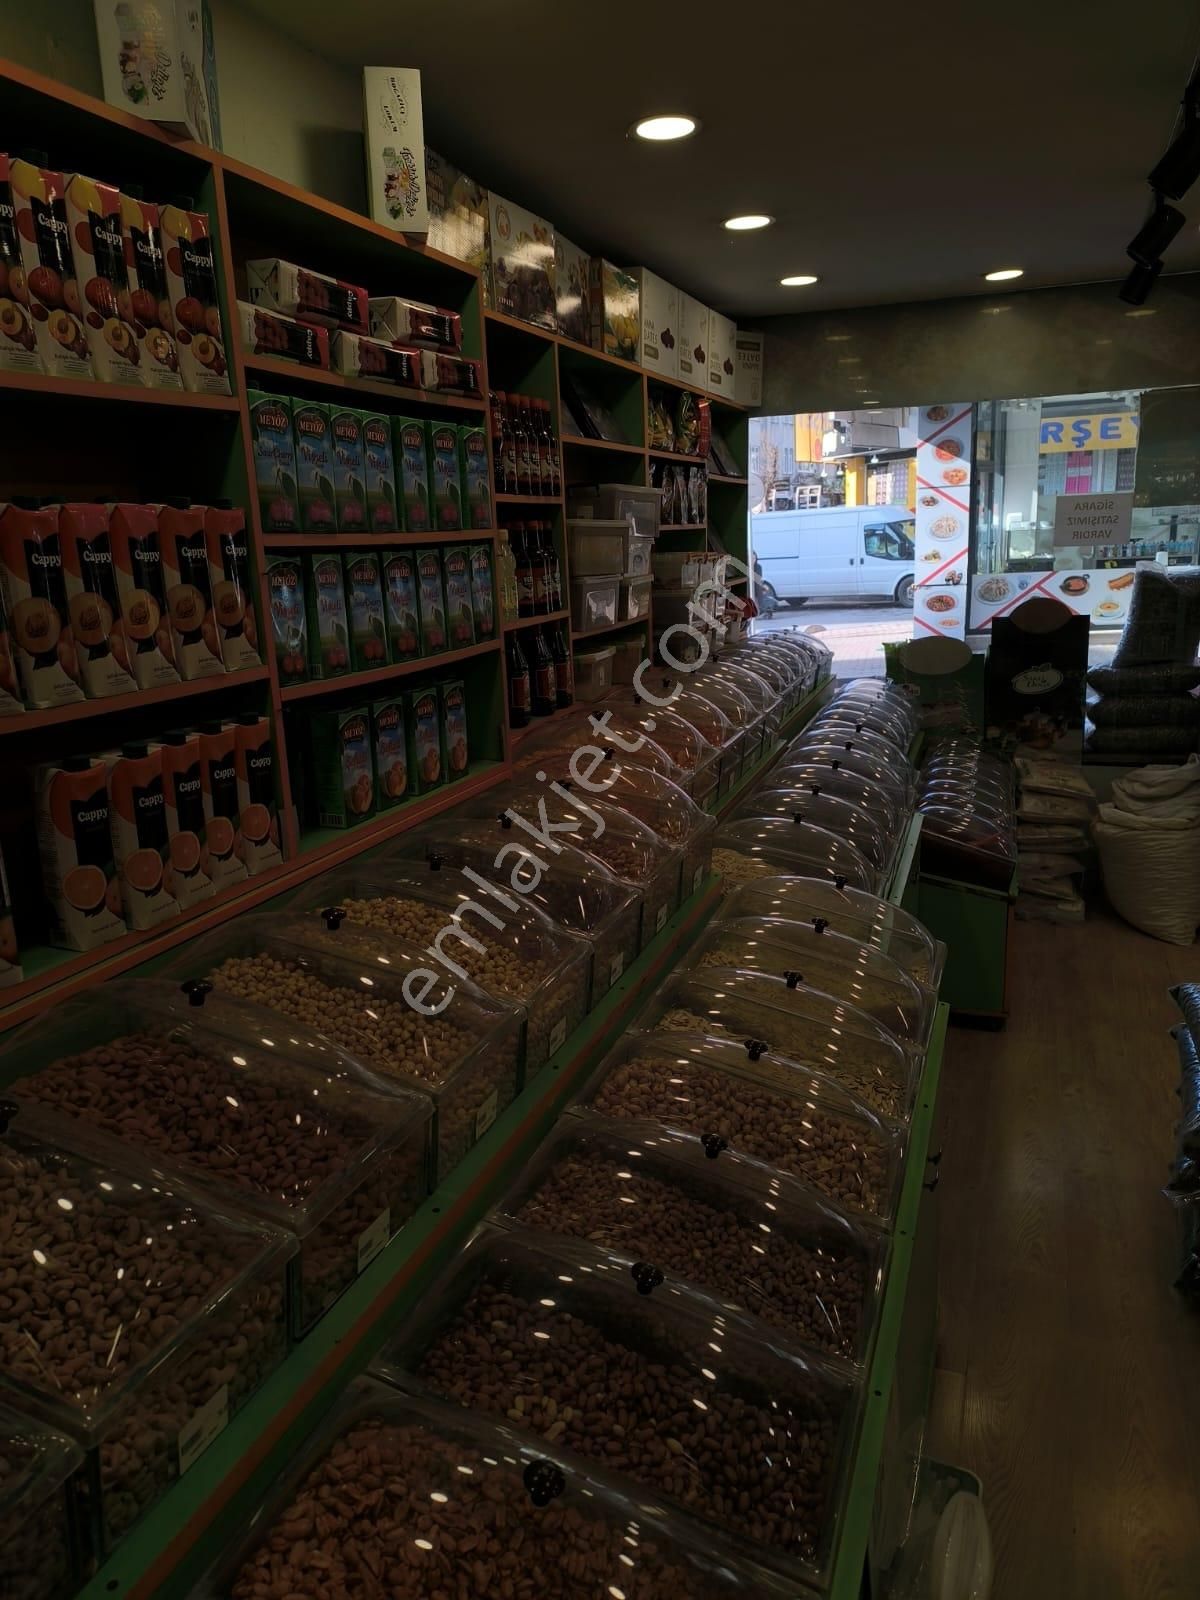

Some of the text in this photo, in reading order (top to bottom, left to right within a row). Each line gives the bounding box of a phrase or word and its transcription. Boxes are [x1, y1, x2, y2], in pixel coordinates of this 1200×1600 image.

[38, 213, 69, 234] Cappy
[94, 226, 122, 250] Cappy
[137, 241, 162, 259] Cappy
[185, 250, 212, 268] Cappy
[305, 328, 314, 360] Cappy
[83, 550, 112, 564] Cappy
[134, 549, 160, 563] Cappy
[181, 546, 208, 559] Cappy
[225, 544, 248, 557] Cappy
[31, 552, 62, 568] Cappy
[250, 756, 272, 769] Cappy
[213, 767, 236, 780] Cappy
[179, 778, 201, 792] Cappy
[138, 792, 164, 808] Cappy
[77, 807, 109, 823] Cappy
